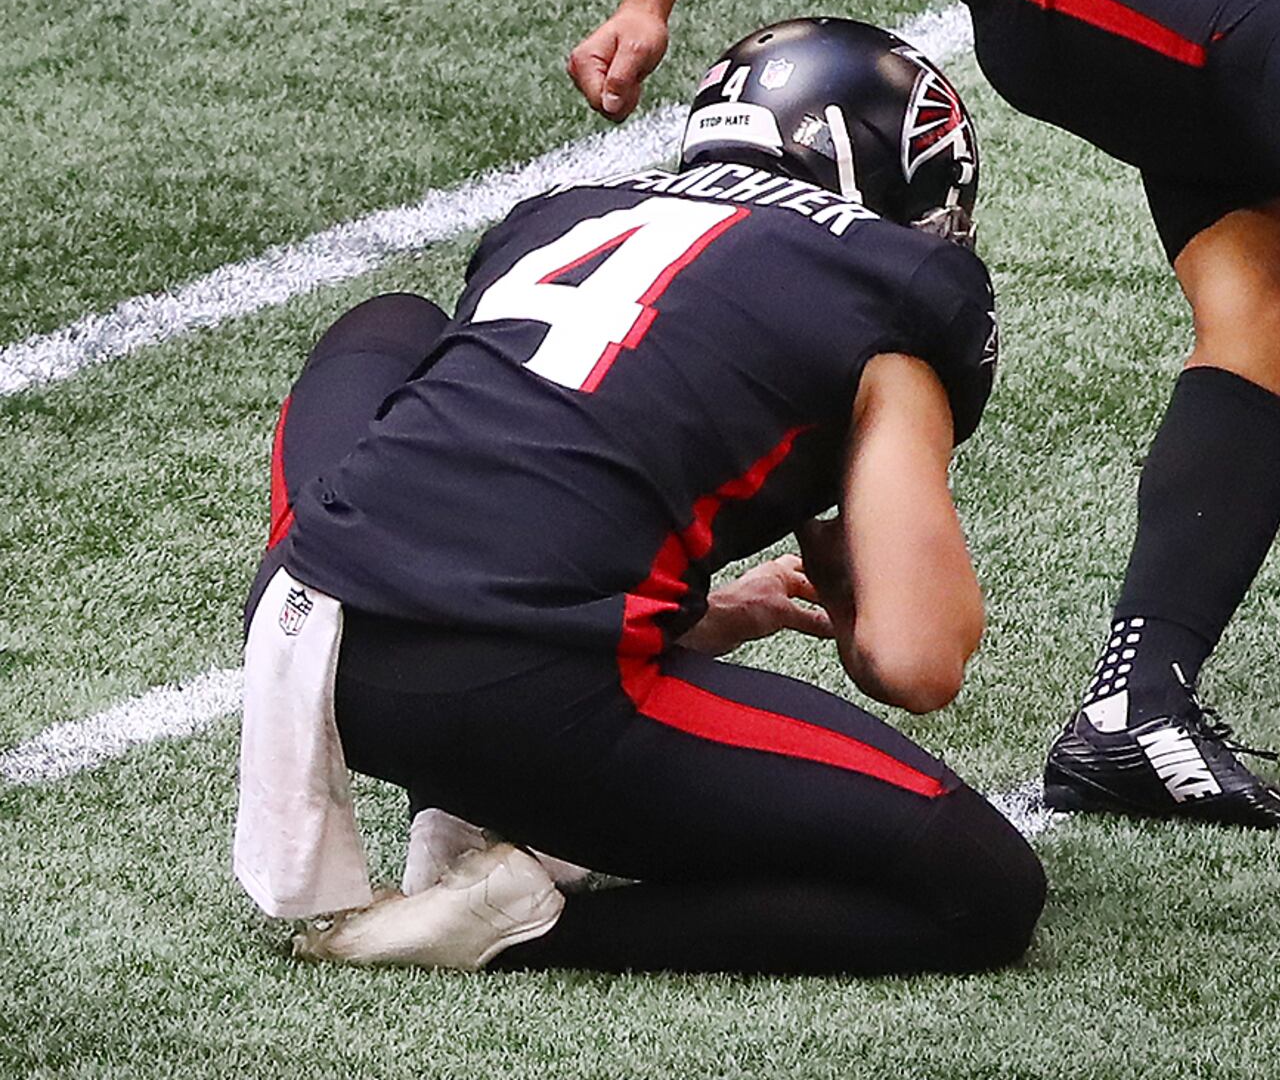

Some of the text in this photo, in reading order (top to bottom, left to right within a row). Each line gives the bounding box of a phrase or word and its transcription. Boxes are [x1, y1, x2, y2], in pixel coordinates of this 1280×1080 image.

[720, 66, 751, 102] 4
[699, 114, 751, 129] STOP HATE
[470, 197, 751, 394] 4
[1136, 726, 1223, 804] NIKE
